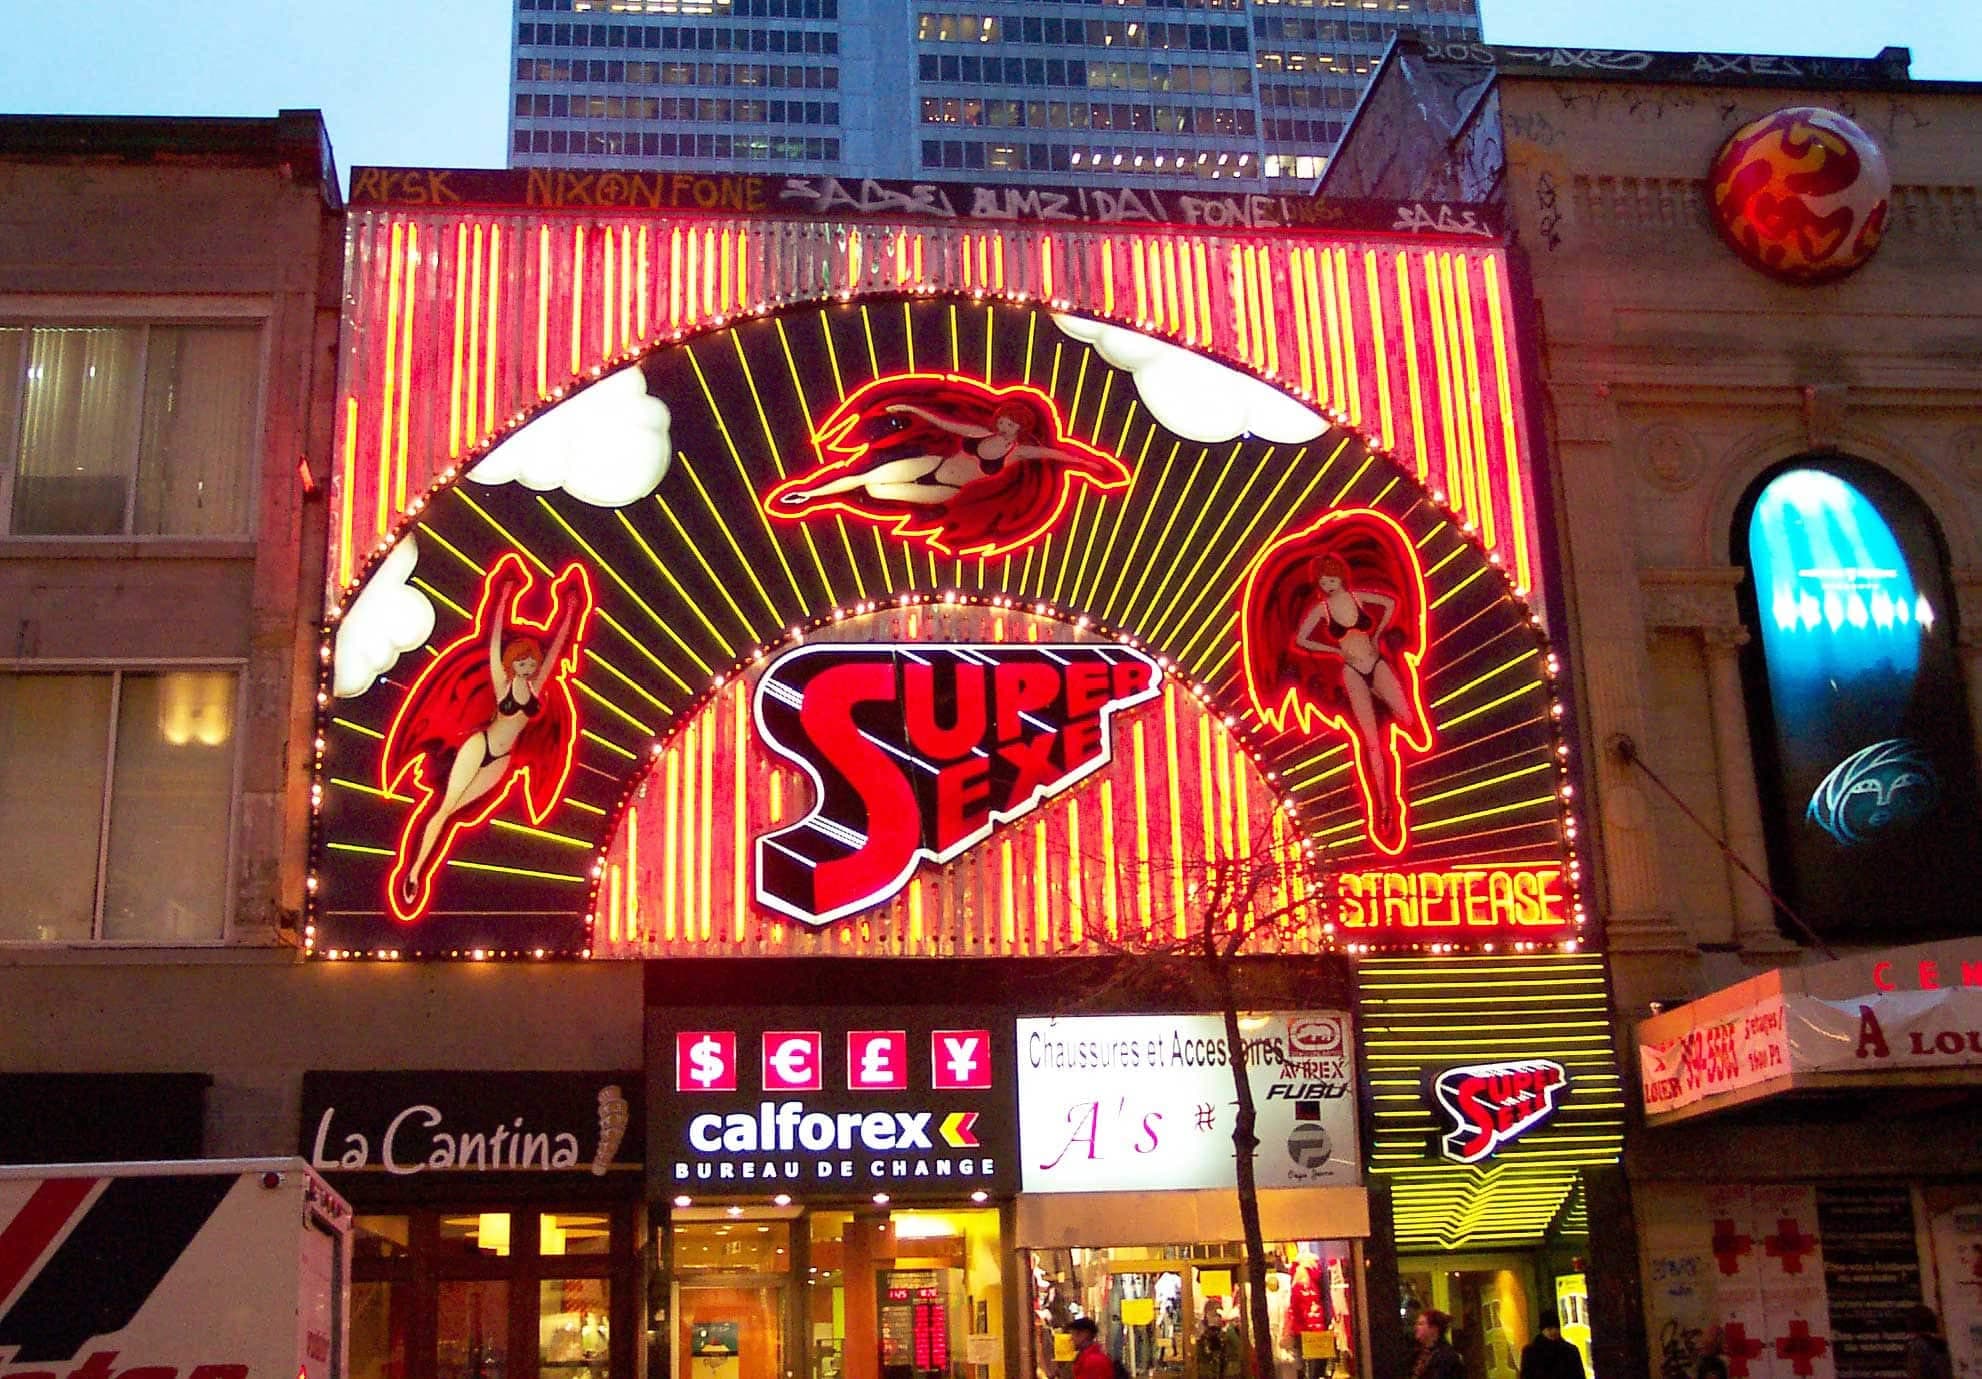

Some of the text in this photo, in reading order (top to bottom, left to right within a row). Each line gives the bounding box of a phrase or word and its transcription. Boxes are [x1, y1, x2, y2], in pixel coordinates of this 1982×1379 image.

[1338, 870, 1565, 929] STRIPTEASE
[1029, 1031, 1140, 1069] Chaussures
[1147, 1033, 1165, 1068] et
[311, 1104, 579, 1175] La Cantina
[688, 1100, 933, 1152] calforex
[1040, 1096, 1163, 1170] A's
[674, 1158, 995, 1179] BUREAU DE CHANGE
